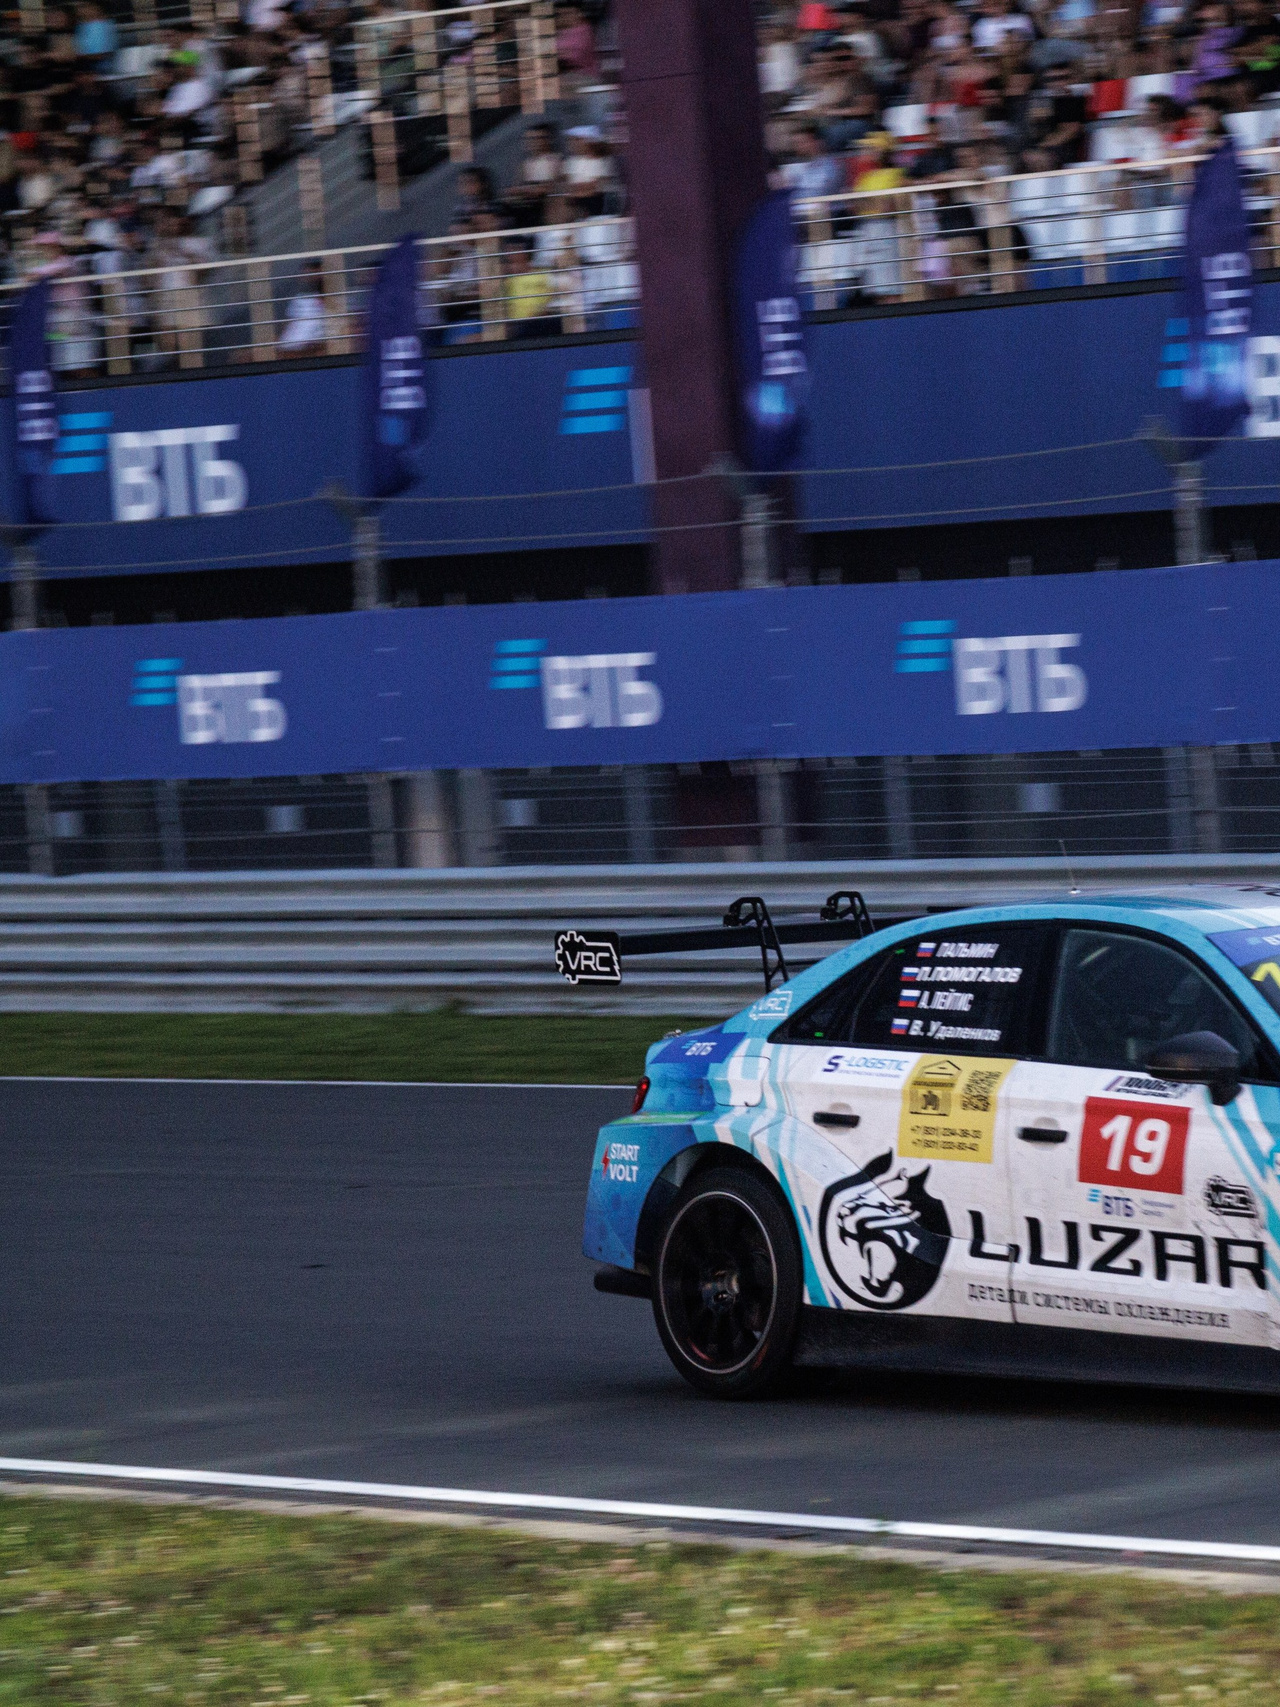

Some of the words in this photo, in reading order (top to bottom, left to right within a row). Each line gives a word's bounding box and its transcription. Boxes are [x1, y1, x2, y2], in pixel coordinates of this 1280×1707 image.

[1201, 252, 1252, 335] ВТБ
[110, 424, 249, 521] ВТБ
[175, 670, 287, 744] ВТБ
[540, 652, 664, 730] ВТБ
[952, 633, 1088, 715] ВТБ
[565, 951, 610, 972] VRC
[609, 1165, 639, 1182] VOLT
[610, 1143, 640, 1161] START
[1100, 1115, 1172, 1176] 19
[1103, 1195, 1134, 1217] ВТБ
[968, 1210, 1268, 1290] LUZAR
